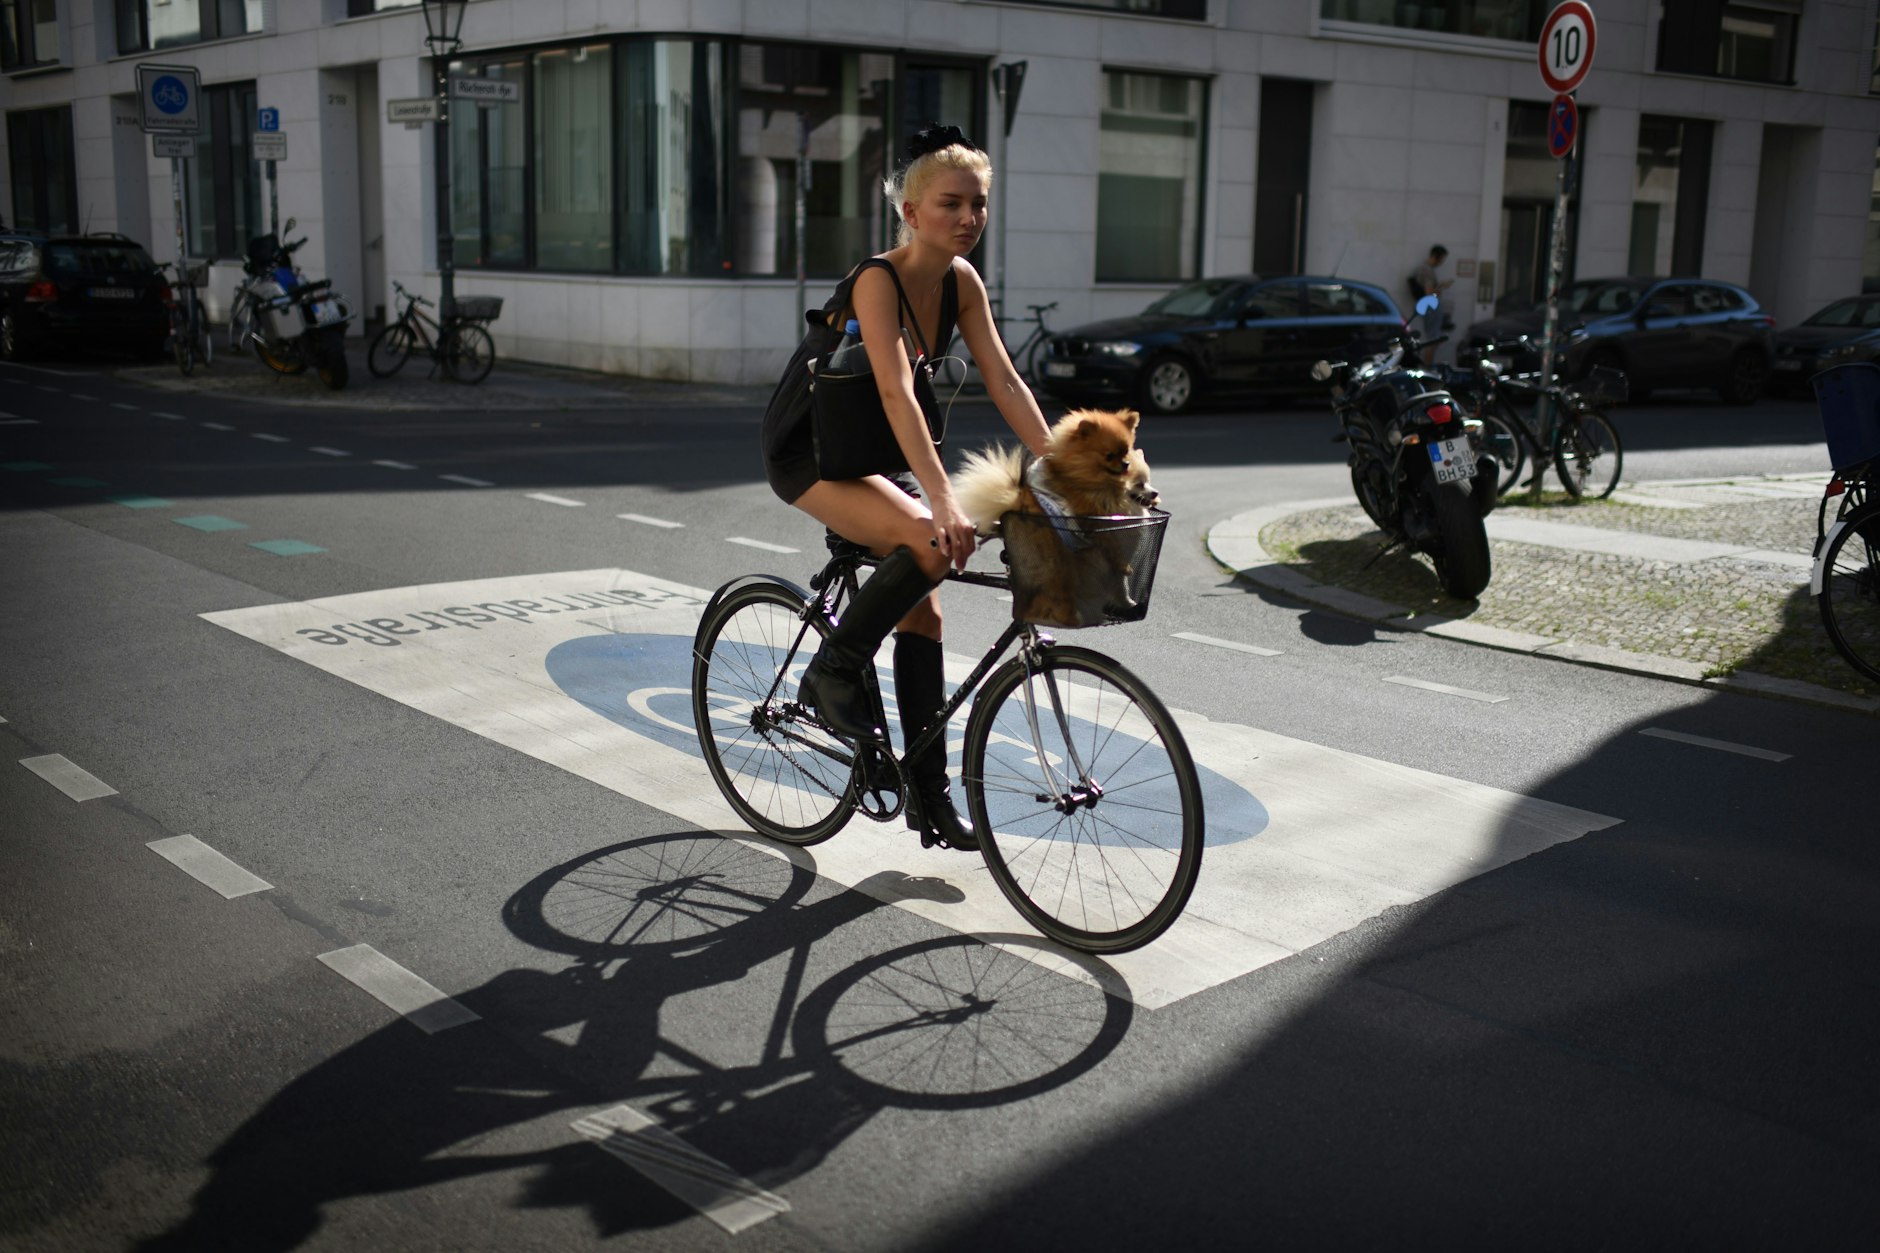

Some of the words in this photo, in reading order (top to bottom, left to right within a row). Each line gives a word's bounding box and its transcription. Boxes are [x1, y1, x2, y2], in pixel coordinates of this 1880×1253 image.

[1553, 26, 1581, 68] 10
[158, 138, 190, 148] Anlieger
[168, 147, 181, 155] frei
[1445, 440, 1455, 452] B
[1438, 467, 1457, 481] BH
[1457, 463, 1475, 477] 53
